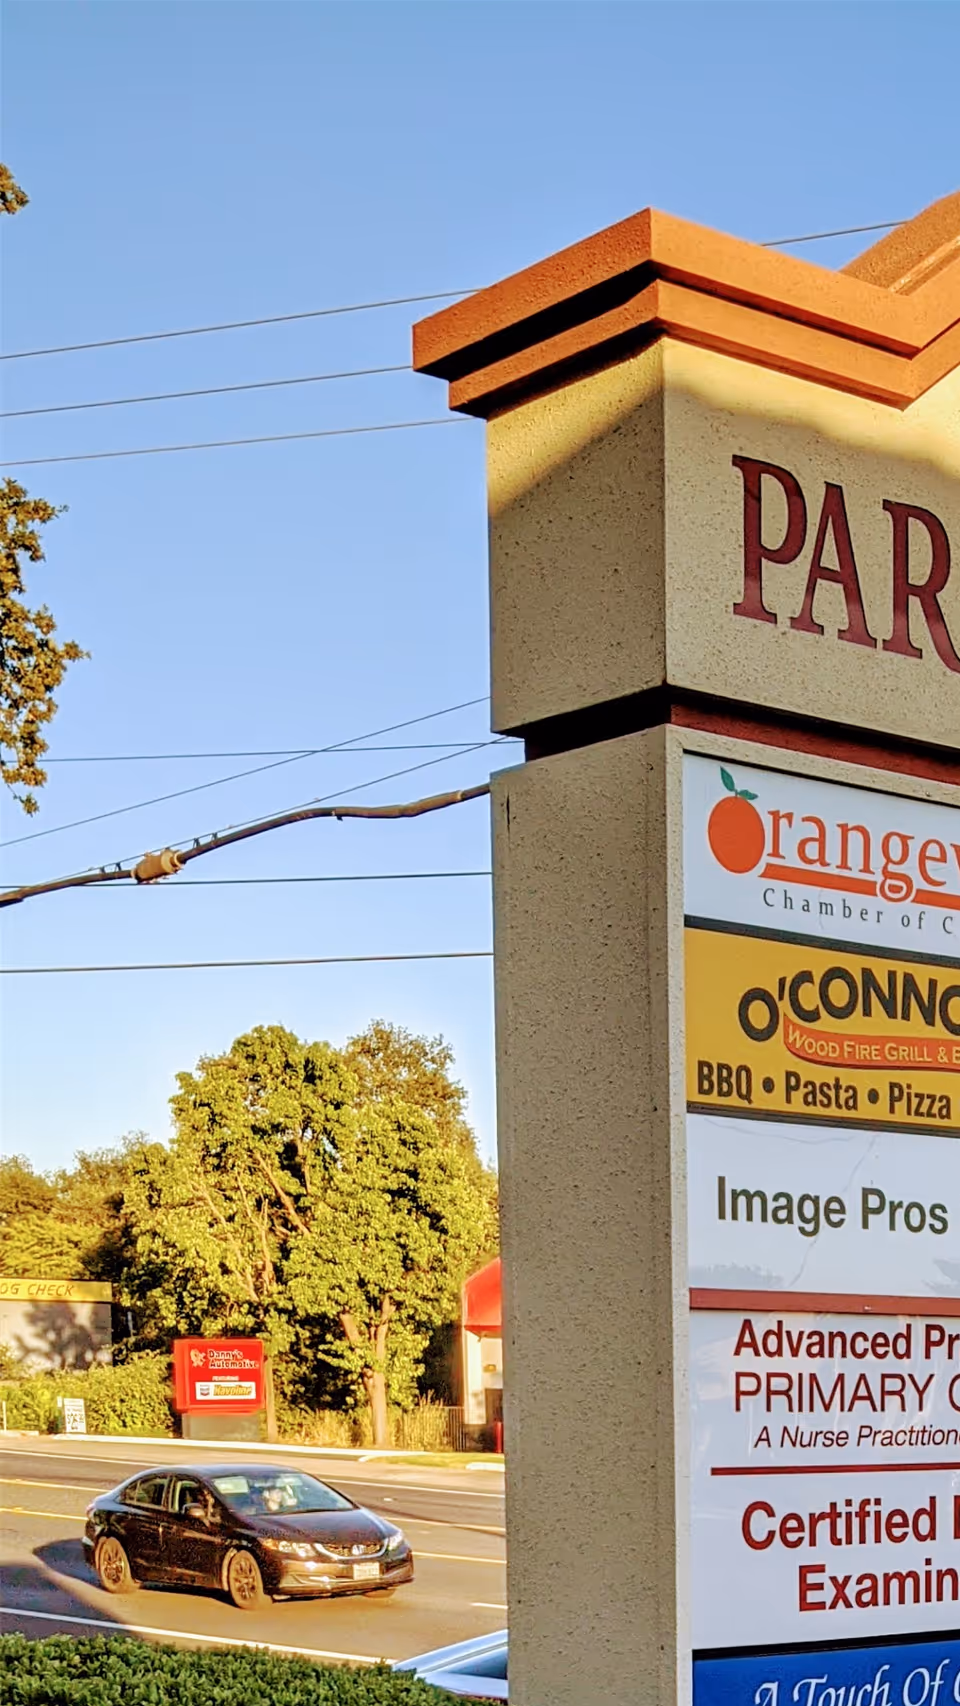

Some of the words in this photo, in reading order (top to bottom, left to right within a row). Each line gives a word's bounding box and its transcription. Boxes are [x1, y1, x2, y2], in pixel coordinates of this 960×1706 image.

[762, 887, 884, 924] Chamber
[901, 911, 926, 931] of
[937, 1044, 950, 1064] &
[697, 1060, 753, 1105] BBQ
[785, 1069, 859, 1112] Pasta
[889, 1081, 952, 1121] Pizza
[716, 1175, 847, 1238] Image
[860, 1186, 949, 1236] Pros
[27, 1283, 75, 1297] CHECK
[207, 1349, 244, 1361] Danny's
[733, 1318, 913, 1361] Advanced
[733, 1371, 936, 1414] PRIMARY
[753, 1425, 772, 1449] A
[779, 1424, 850, 1449] Nurse
[740, 1494, 938, 1552] Certified
